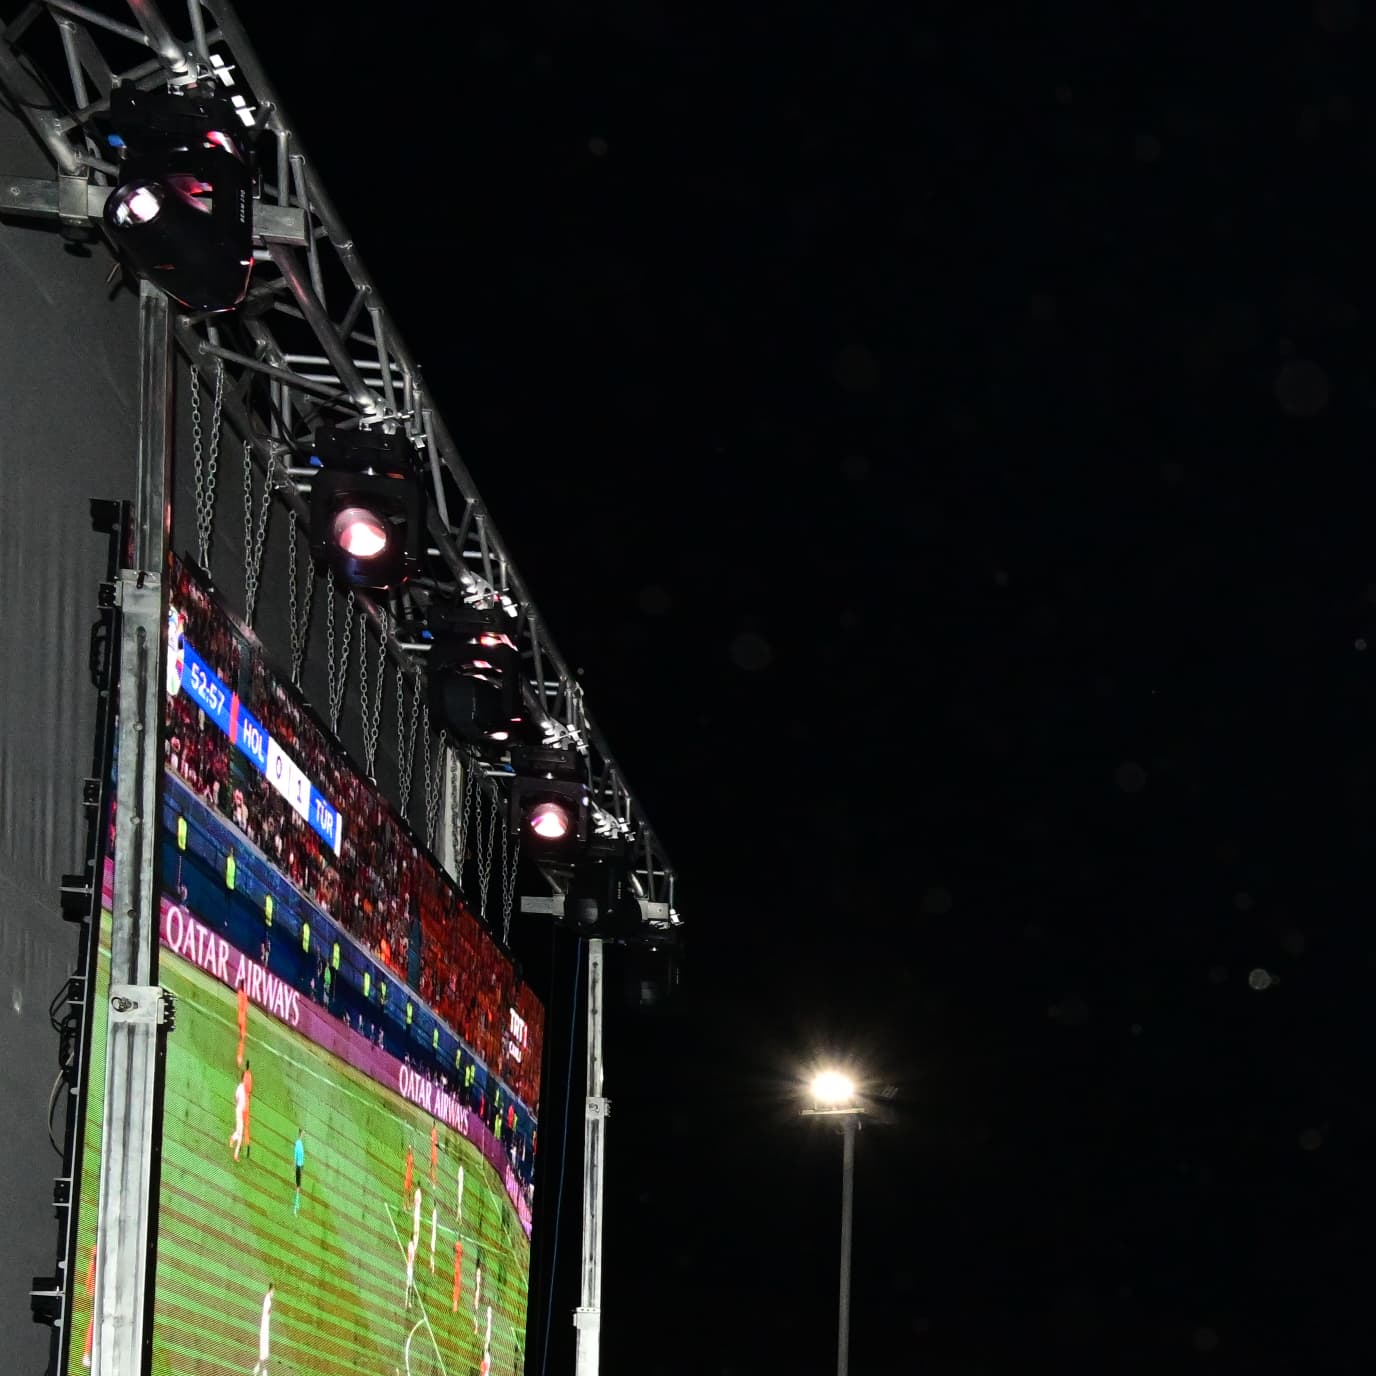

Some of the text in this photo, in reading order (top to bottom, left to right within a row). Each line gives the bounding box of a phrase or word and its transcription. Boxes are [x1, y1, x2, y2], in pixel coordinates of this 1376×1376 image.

[191, 663, 225, 715] 52:57
[243, 718, 265, 761] HOL
[276, 755, 282, 779] 0
[315, 799, 334, 838] TÜR
[166, 907, 300, 1028] QATAR AIRWAYS
[399, 1065, 469, 1136] QATAR AIRWAYS
